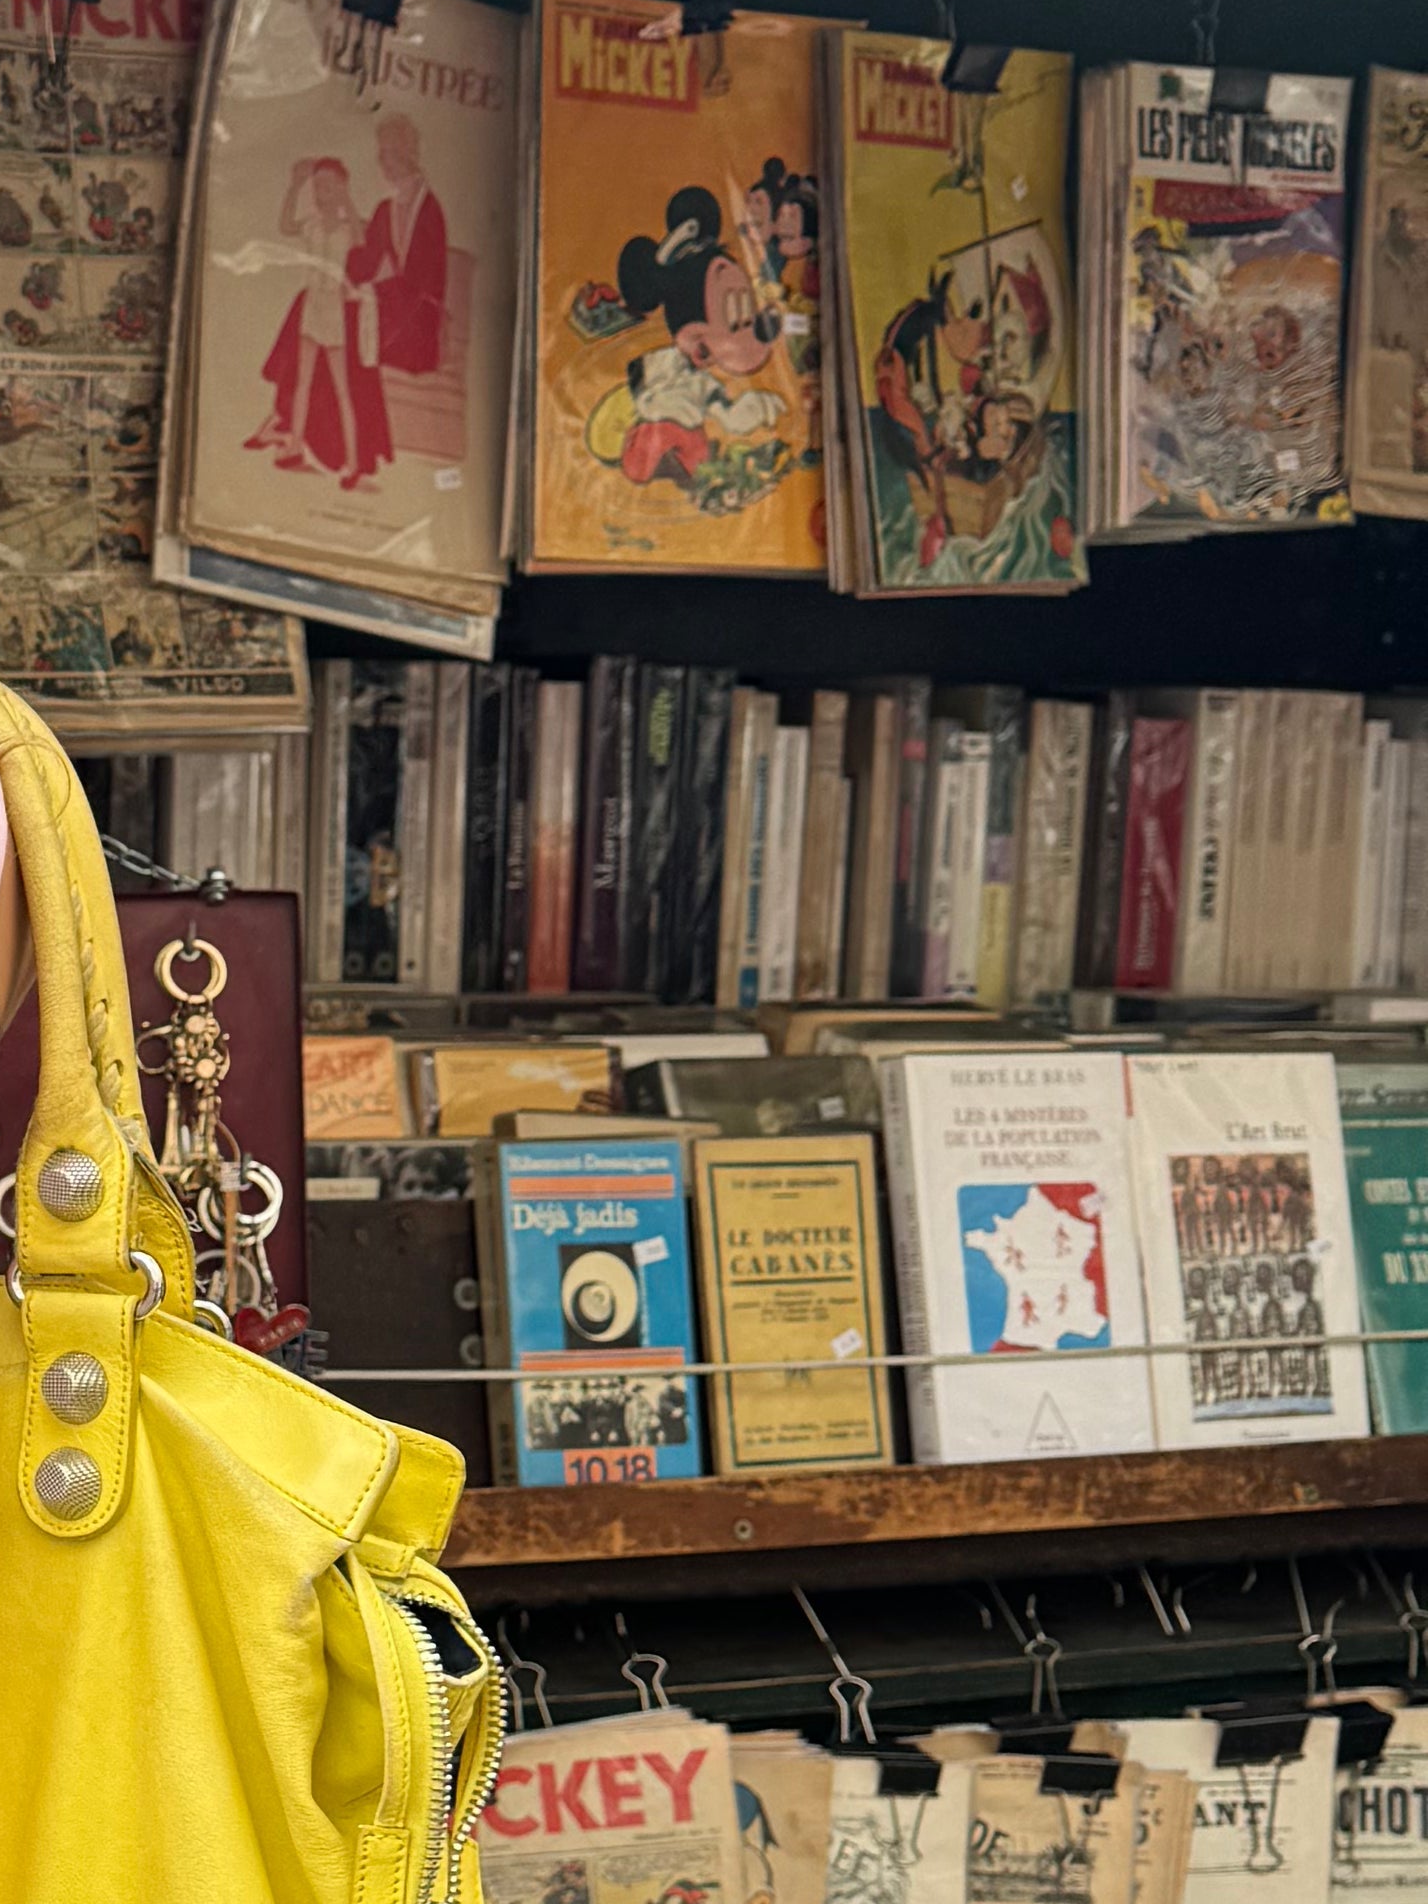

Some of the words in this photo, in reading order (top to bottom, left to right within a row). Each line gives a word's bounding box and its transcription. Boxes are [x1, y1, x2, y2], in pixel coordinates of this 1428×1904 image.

[1137, 107, 1173, 160] LES
[949, 1066, 1009, 1088] HERVÉ
[1012, 1068, 1036, 1088] LE
[952, 1106, 987, 1127] LES
[943, 1129, 968, 1147] DE
[971, 1129, 995, 1147] LA
[998, 1127, 1103, 1146] POPULATION
[512, 1202, 571, 1236] Déjà
[572, 1200, 639, 1236] jadis
[727, 1228, 754, 1248] LE
[762, 1226, 855, 1247] DOCTEUR
[728, 1248, 855, 1277] CABANÈS
[569, 1455, 607, 1484] 10
[616, 1453, 652, 1483] 18
